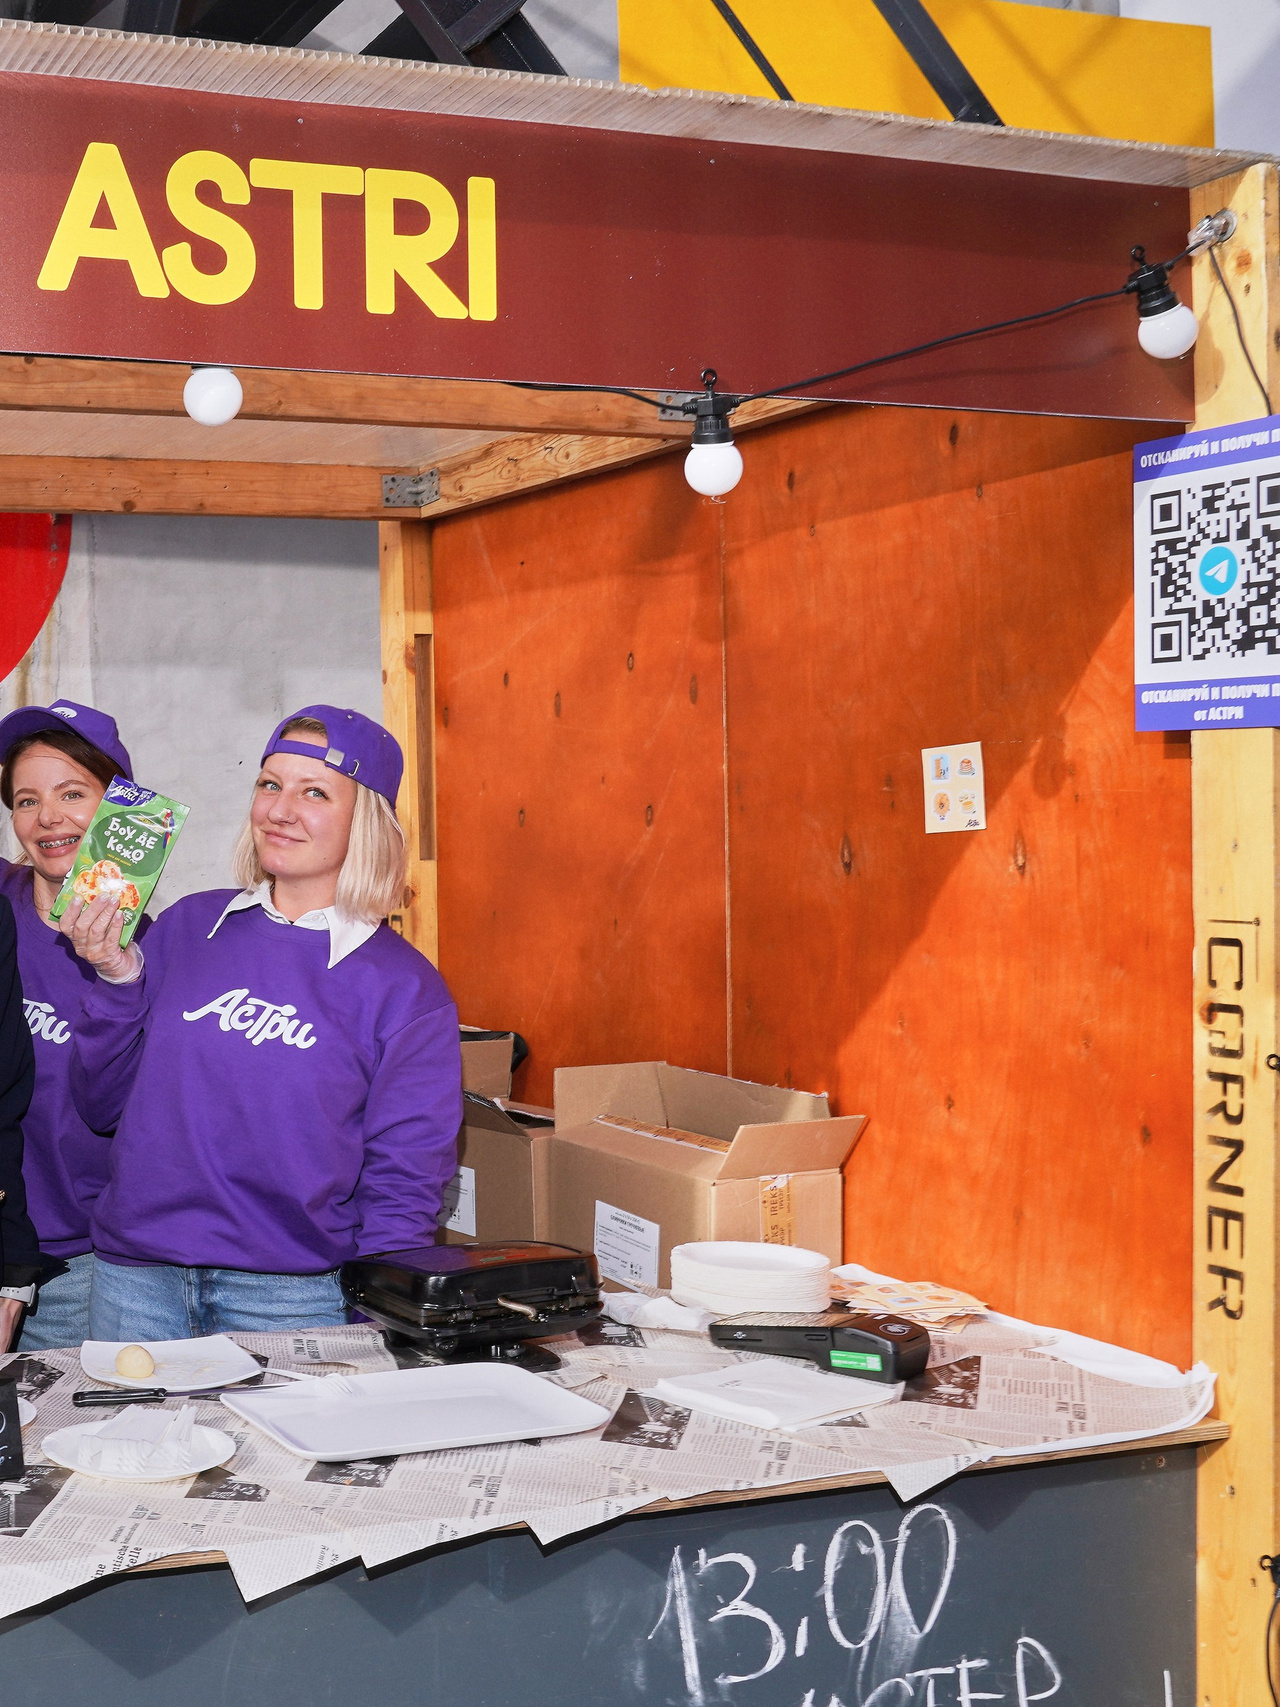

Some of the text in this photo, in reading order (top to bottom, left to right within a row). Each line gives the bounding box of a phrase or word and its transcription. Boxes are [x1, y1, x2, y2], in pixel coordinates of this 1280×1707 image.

[36, 141, 498, 322] ASTRI
[1140, 439, 1210, 468] ОТСКАНИРУЙ
[1210, 440, 1220, 455] И
[1221, 430, 1270, 453] ПОЛУЧИ
[1141, 684, 1210, 704] ОТСКАНИРУЙ
[1211, 686, 1220, 701] И
[1221, 683, 1270, 700] ПОЛУЧИ
[1208, 705, 1244, 721] АСТРИ
[182, 988, 318, 1050] Астри
[647, 1502, 958, 1707] 13:00
